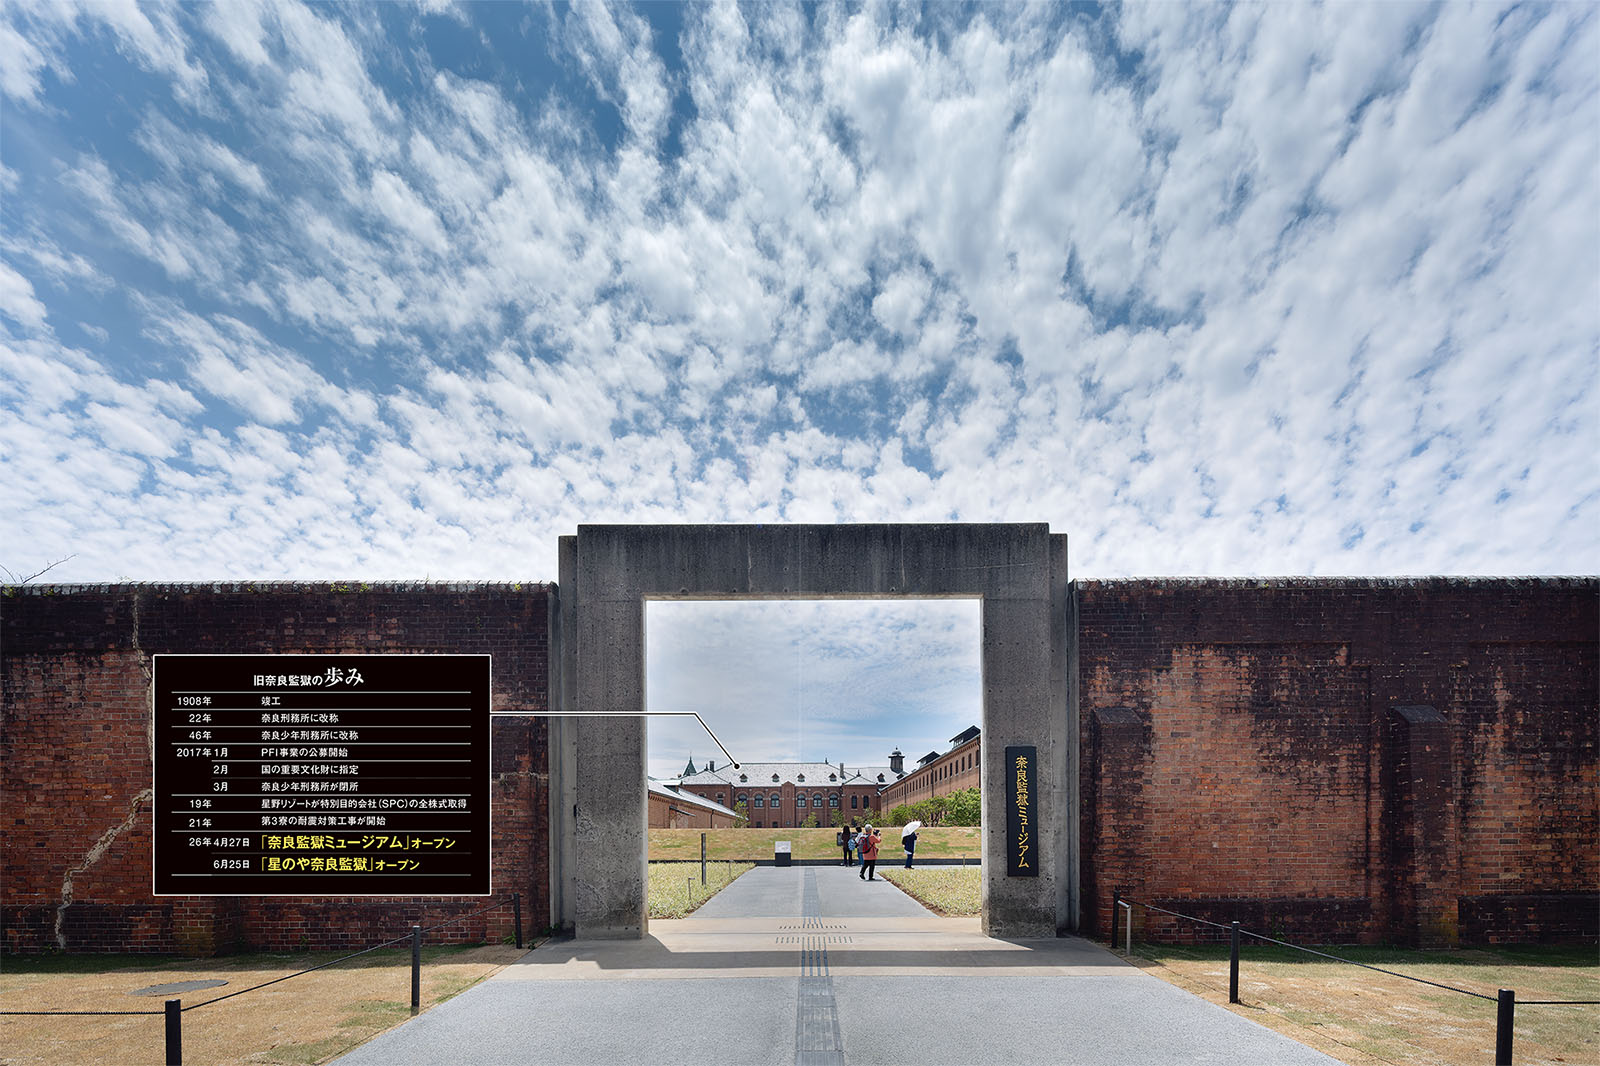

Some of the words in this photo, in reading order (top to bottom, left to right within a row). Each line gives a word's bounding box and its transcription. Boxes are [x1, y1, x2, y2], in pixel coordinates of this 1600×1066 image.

[1015, 755, 1030, 868] 奈良監獄ミュージアム
